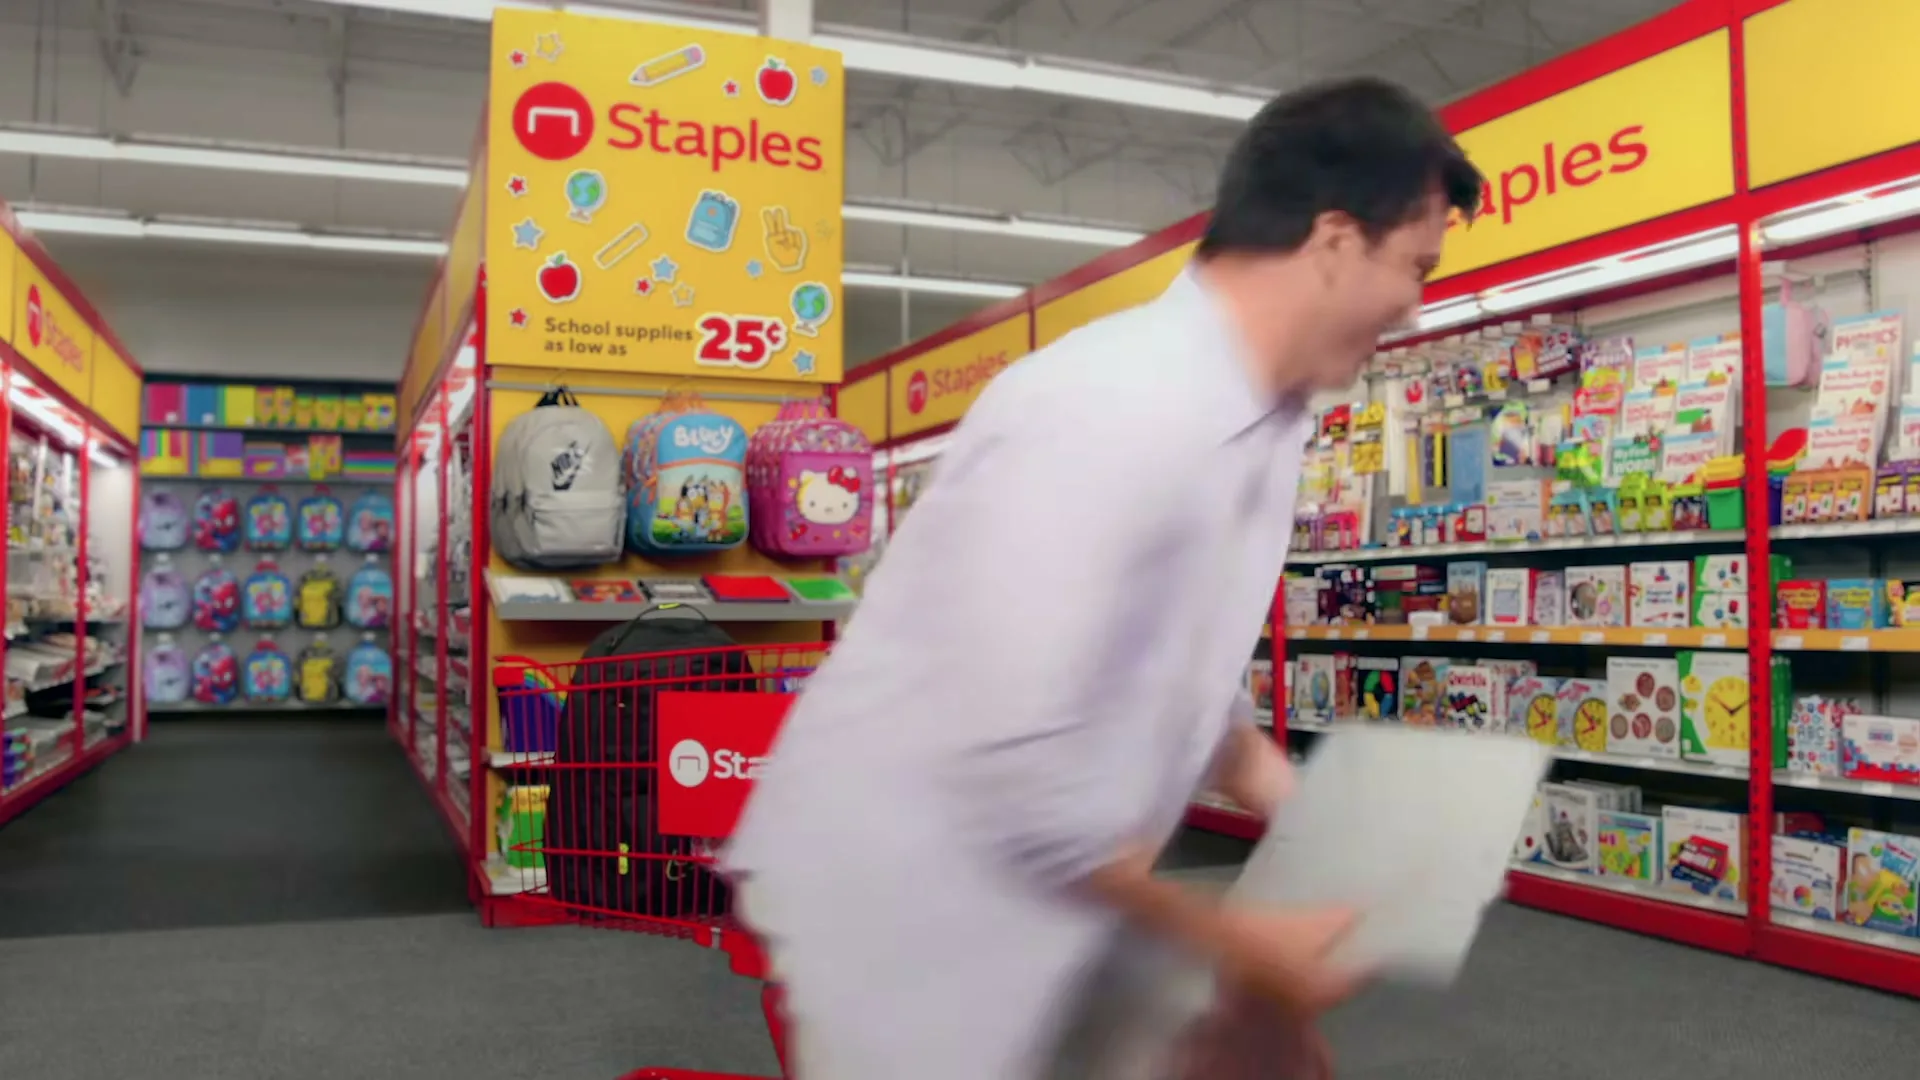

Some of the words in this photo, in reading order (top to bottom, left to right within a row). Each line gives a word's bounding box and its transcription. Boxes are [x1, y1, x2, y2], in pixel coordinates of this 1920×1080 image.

[607, 103, 823, 172] Staples
[544, 340, 564, 353] as
[569, 337, 603, 354] low
[608, 342, 628, 357] as
[545, 316, 611, 336] School
[616, 325, 693, 342] supplies
[699, 316, 782, 363] 25¢
